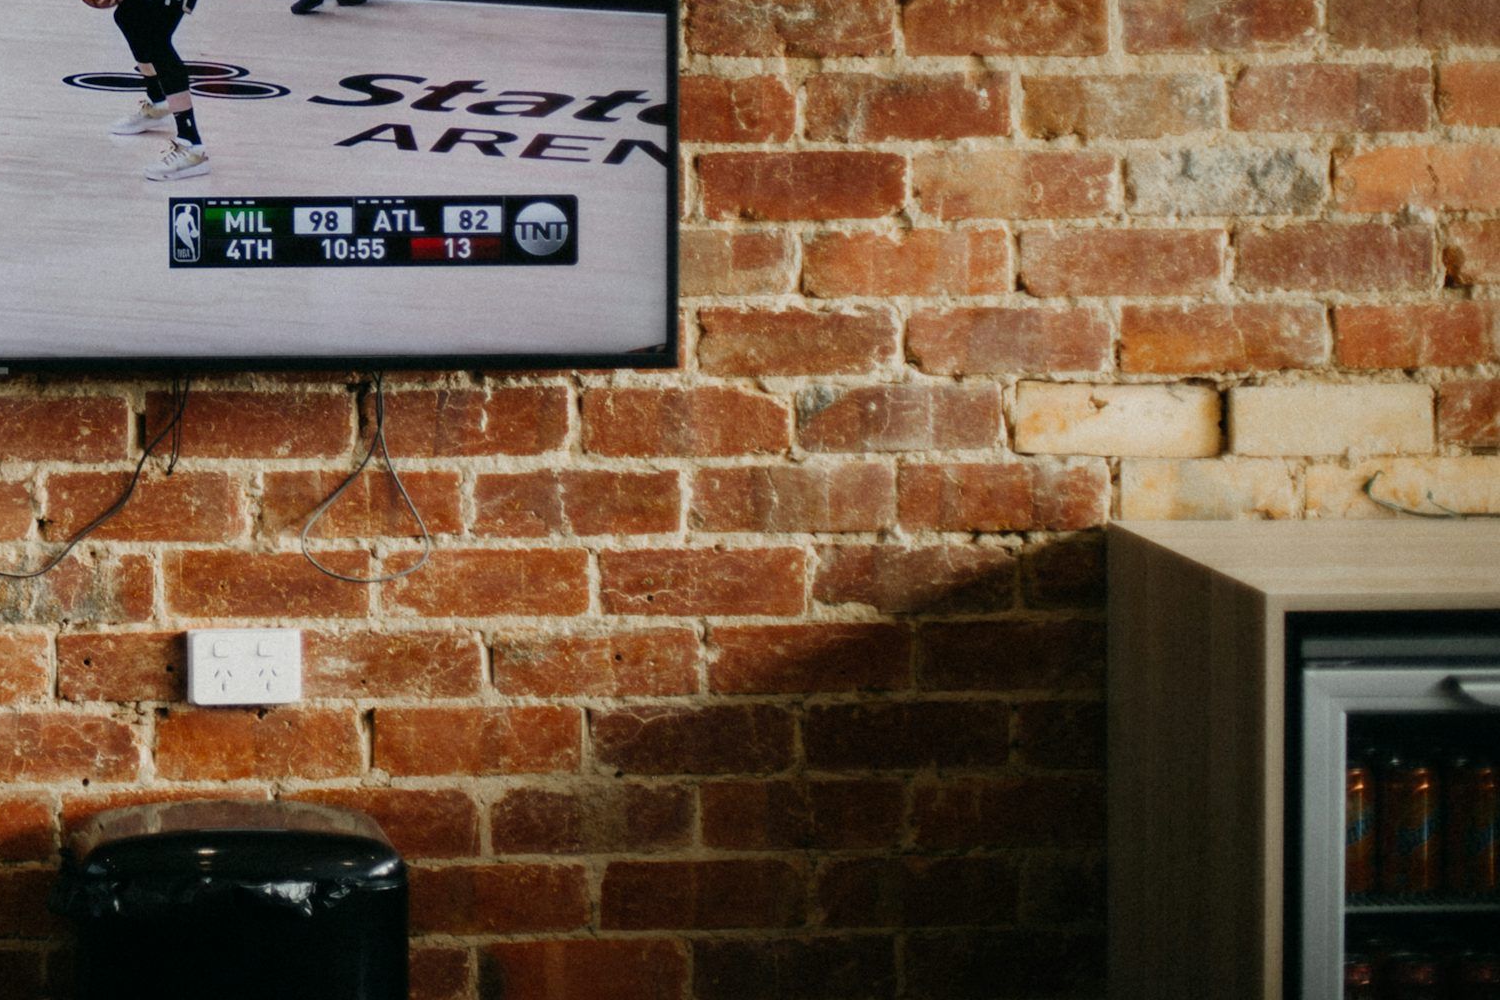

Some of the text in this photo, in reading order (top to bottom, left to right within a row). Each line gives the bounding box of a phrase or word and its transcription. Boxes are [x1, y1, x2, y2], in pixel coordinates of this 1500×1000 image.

[225, 209, 489, 233] MIL 98 ATL 82
[515, 221, 568, 241] TNT
[176, 248, 191, 259] NBA
[226, 237, 472, 260] 4TH 10:55 13
